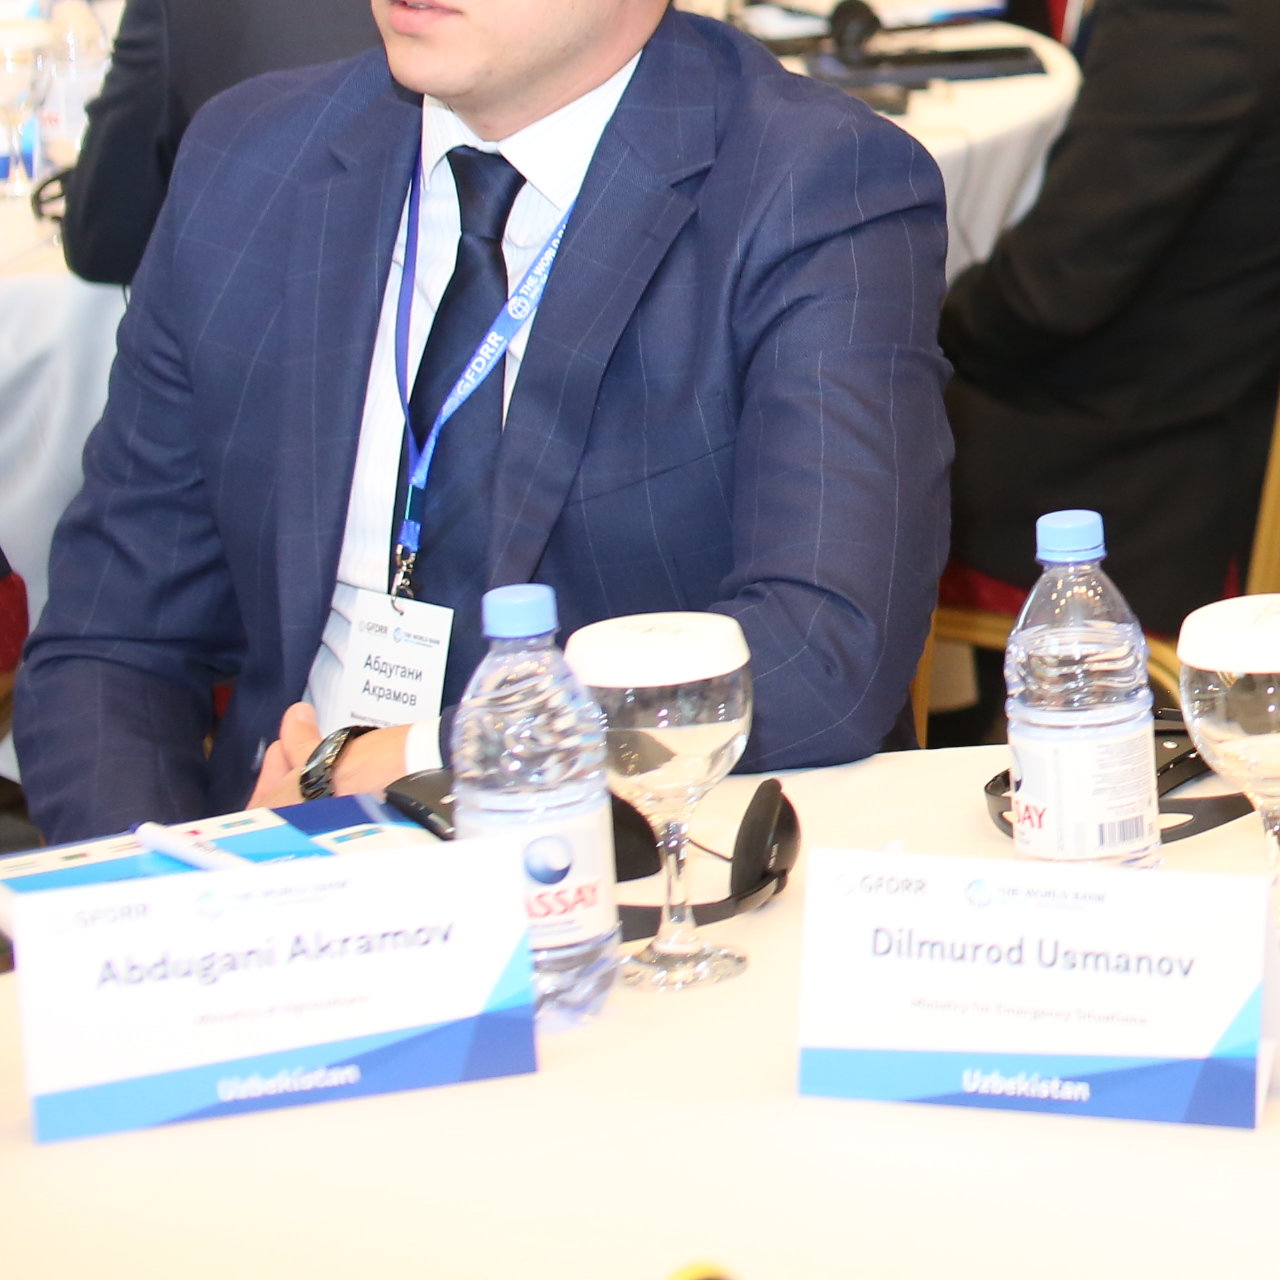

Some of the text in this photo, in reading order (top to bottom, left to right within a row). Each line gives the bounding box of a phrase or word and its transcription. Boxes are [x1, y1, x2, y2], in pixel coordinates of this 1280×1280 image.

[519, 274, 539, 297] THE
[457, 331, 504, 396] GFDRR
[363, 654, 423, 681] Абдугани
[362, 679, 417, 706] Акрамов
[859, 874, 927, 897] GFDRR
[97, 921, 455, 991] Abdugani Akramov
[872, 926, 1196, 978] Dilmurod Usmanov
[216, 1063, 360, 1102] Uzbekistan
[961, 1067, 1092, 1103] Uzbekistan
